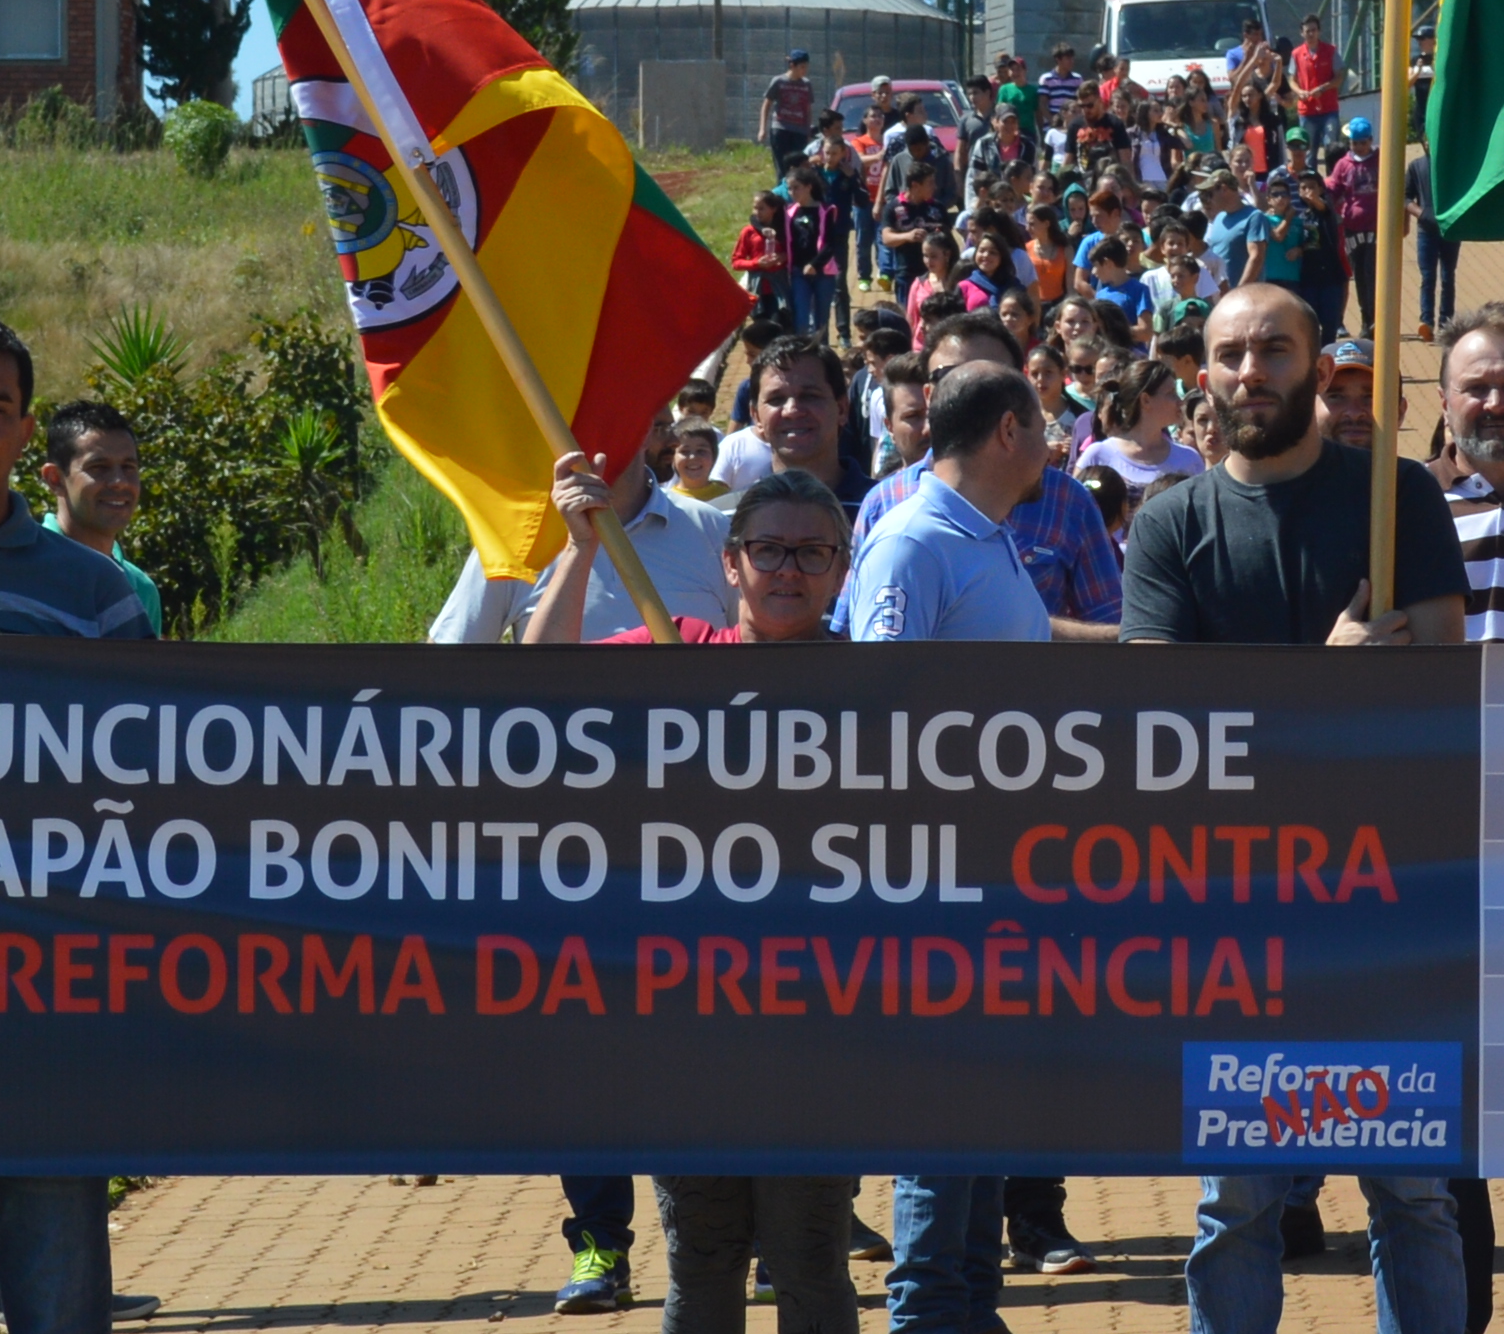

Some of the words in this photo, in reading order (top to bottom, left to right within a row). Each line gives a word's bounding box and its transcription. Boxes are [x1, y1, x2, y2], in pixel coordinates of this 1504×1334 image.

[873, 585, 907, 636] 3
[647, 692, 1105, 791] PÚBLICOS
[1136, 711, 1256, 792] DE
[249, 819, 608, 903] BONITO
[641, 822, 780, 903] DO
[809, 823, 983, 904] SUL
[1010, 823, 1398, 905] CONTRA
[475, 935, 607, 1017] DA
[635, 920, 1286, 1018] PREVIDÊNCIA!
[1208, 1053, 1391, 1104] Reforma
[1397, 1063, 1436, 1093] da
[1261, 1069, 1389, 1144] NÃO
